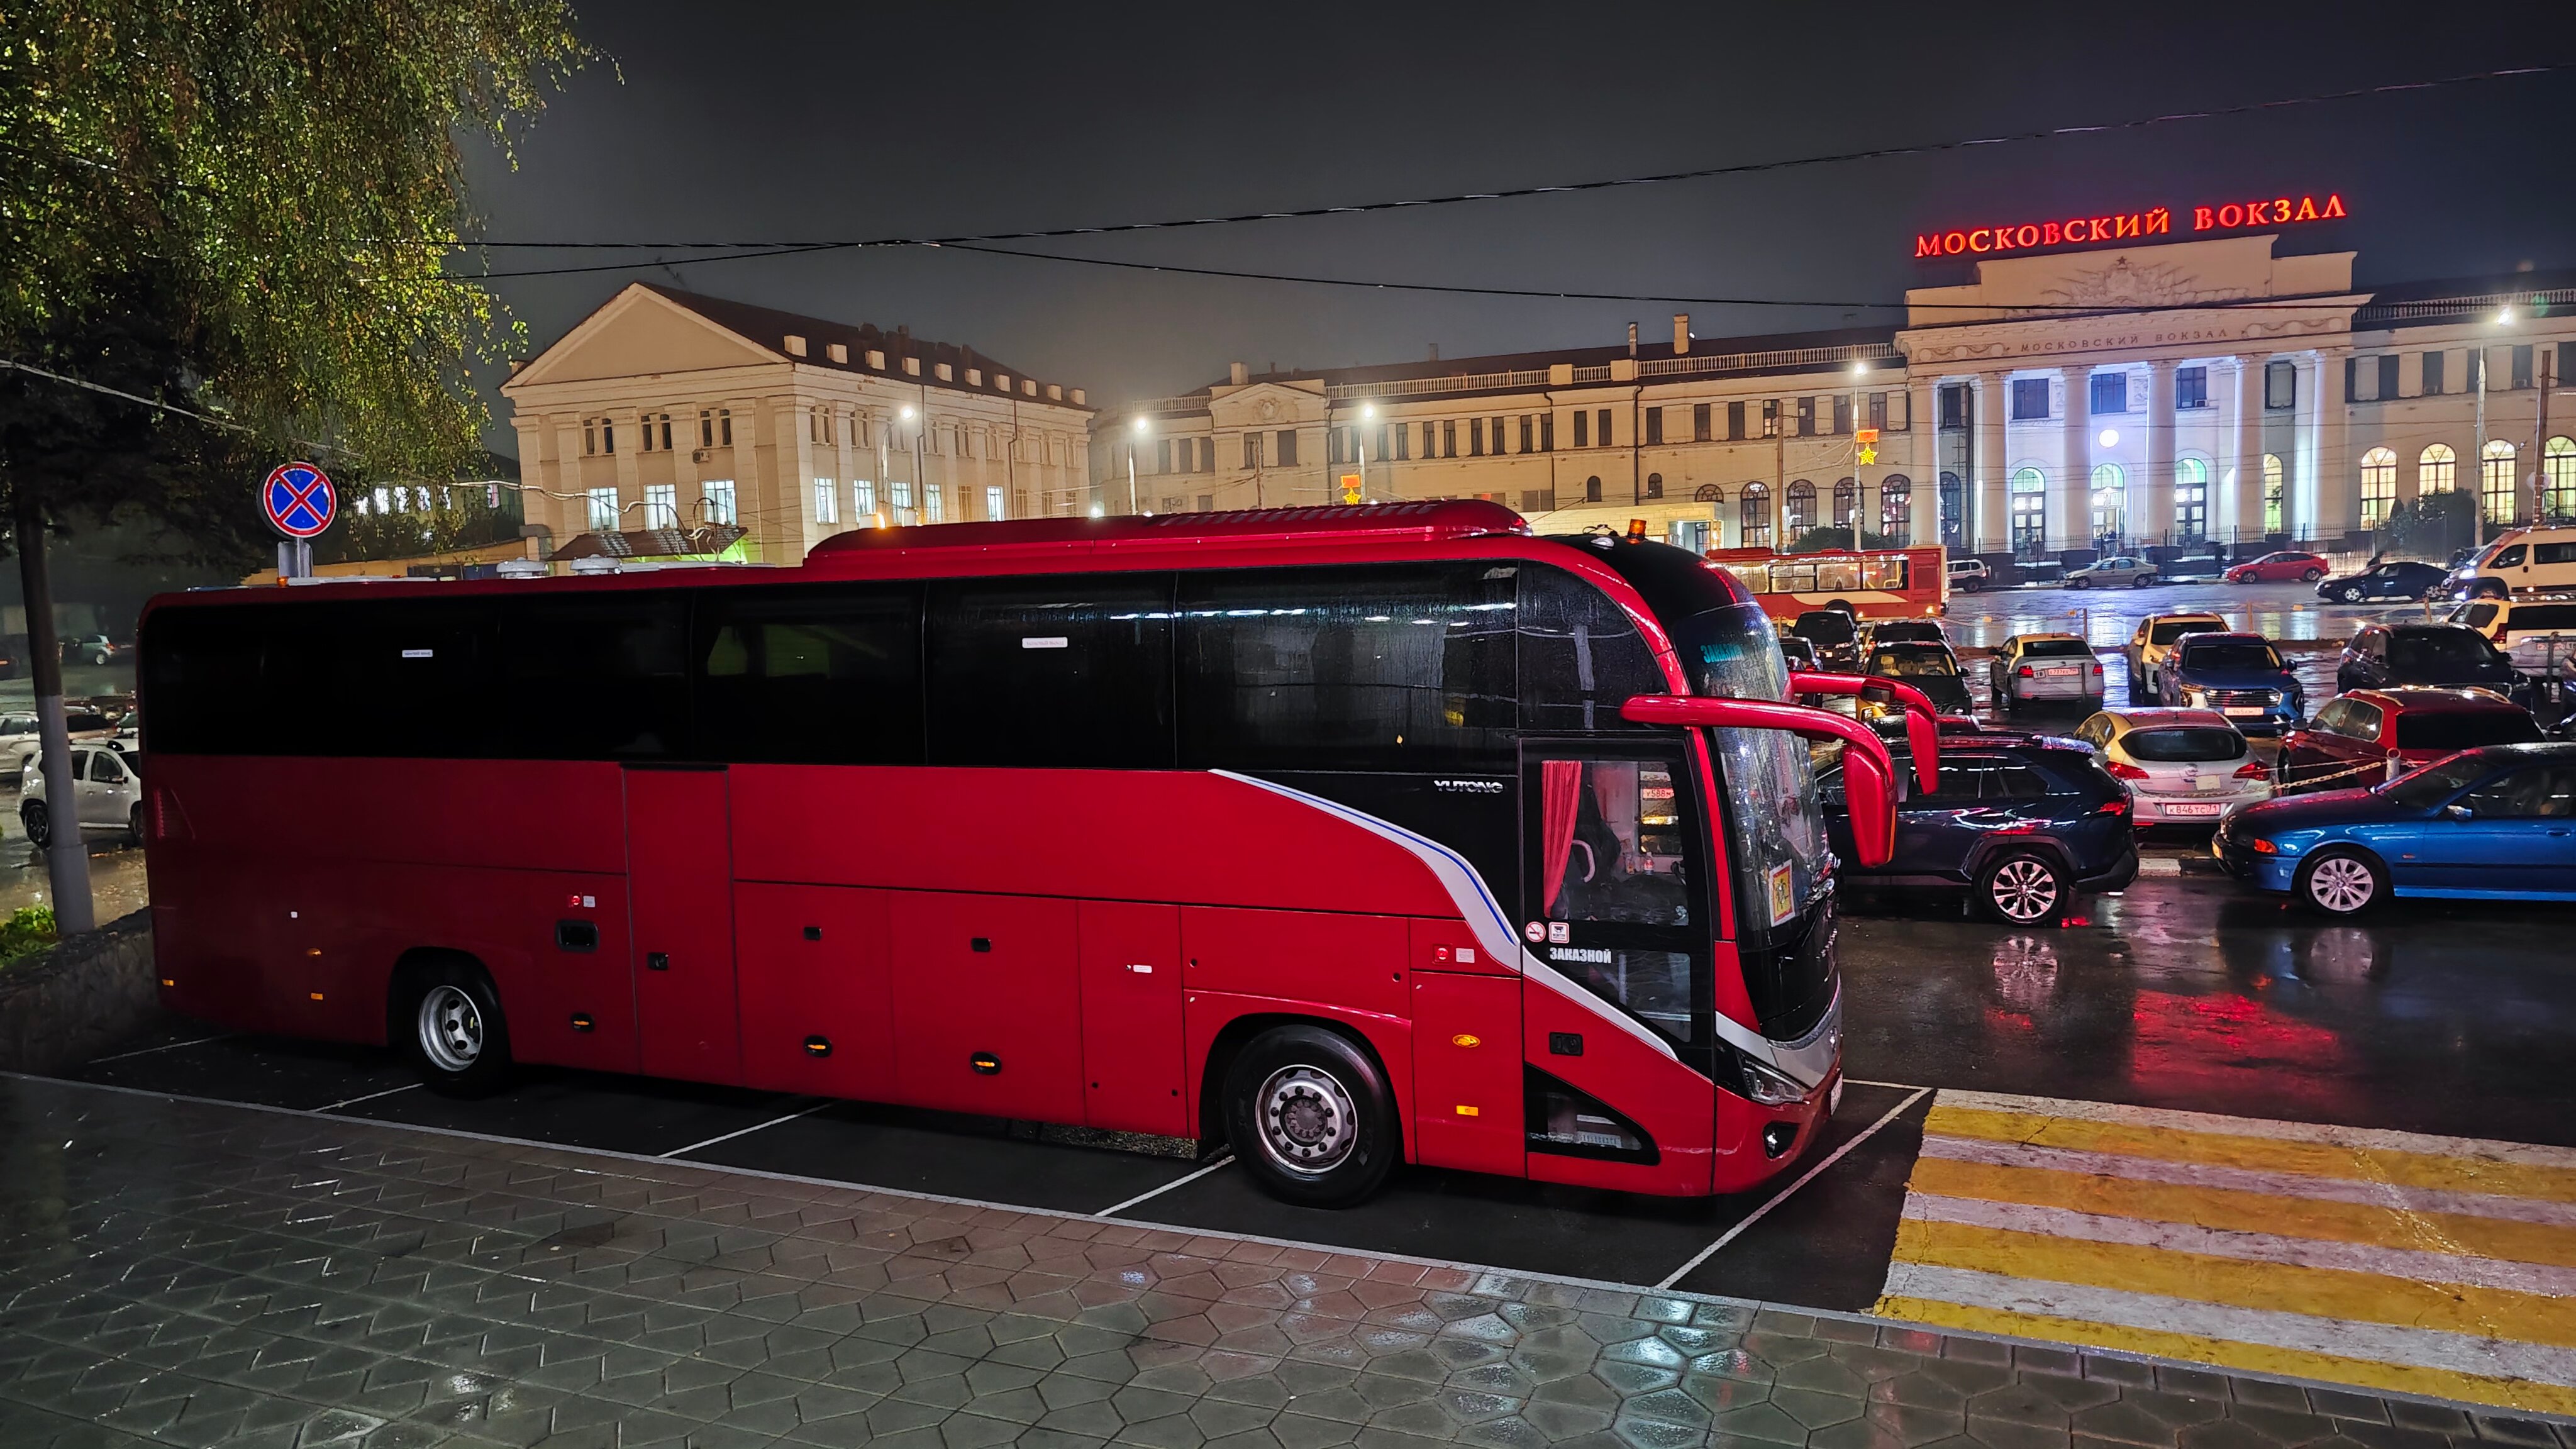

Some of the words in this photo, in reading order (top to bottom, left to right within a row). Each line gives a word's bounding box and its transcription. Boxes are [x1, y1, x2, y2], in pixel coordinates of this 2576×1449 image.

[1914, 207, 2169, 257] МОСКОВСКИЙ
[2194, 194, 2346, 231] ВОКЗАЛ
[2020, 333, 2138, 352] МОСКОВСКИЙ
[2155, 328, 2228, 342] ВОКЗАЛ
[1433, 780, 1504, 793] YUTONG
[1549, 947, 1612, 963] ЗАКАЗНОЙ
